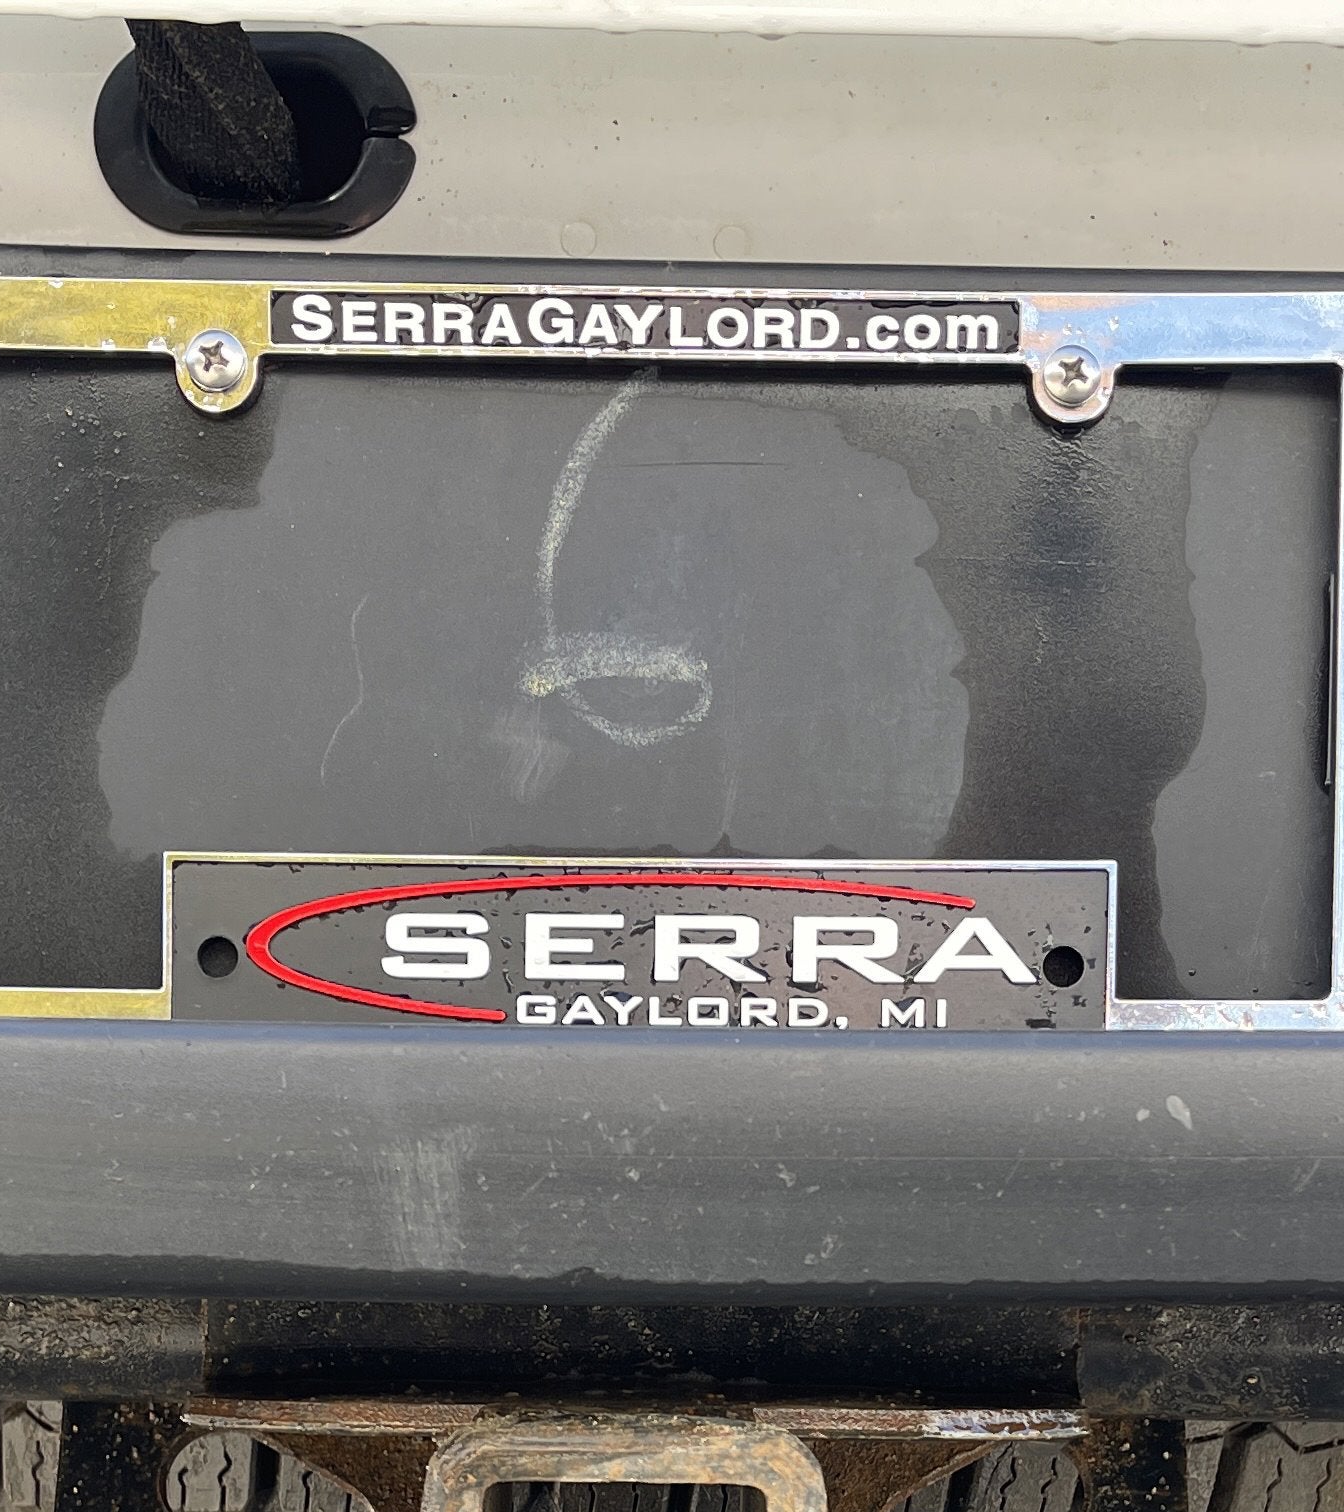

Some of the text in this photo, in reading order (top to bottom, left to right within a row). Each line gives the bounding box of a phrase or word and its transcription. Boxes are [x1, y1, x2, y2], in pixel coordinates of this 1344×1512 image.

[380, 911, 1040, 986] SERRA
[515, 994, 949, 1031] GAYLORD, MI
